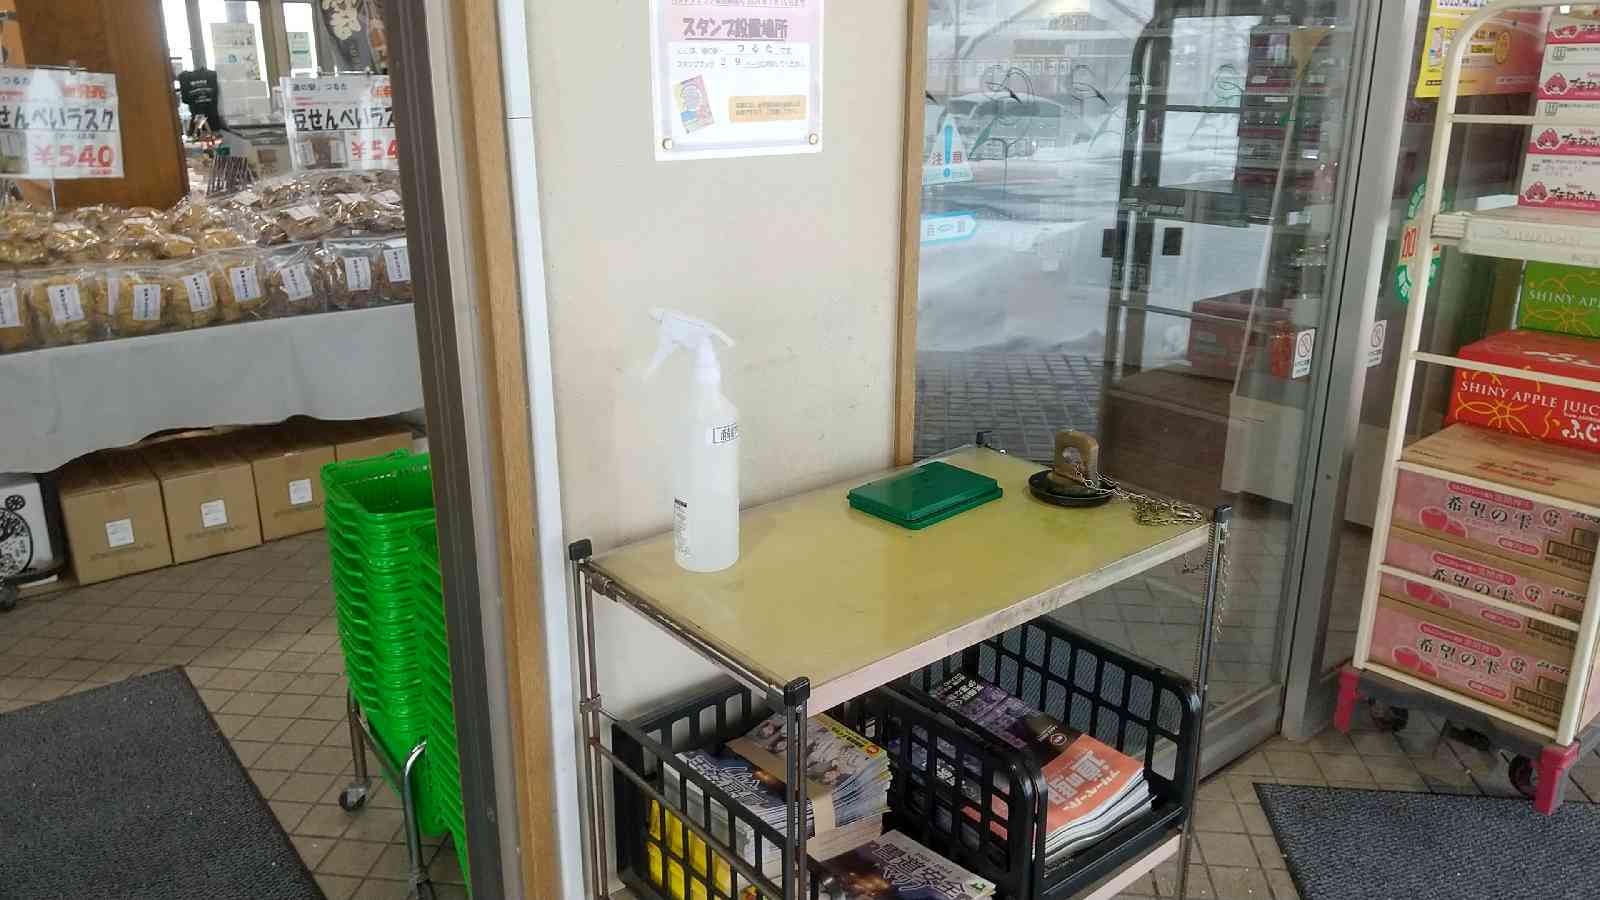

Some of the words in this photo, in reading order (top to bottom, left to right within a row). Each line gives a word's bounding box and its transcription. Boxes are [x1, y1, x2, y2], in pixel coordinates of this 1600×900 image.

[682, 17, 789, 38] スタンプ設置場所
[32, 143, 115, 168] ¥540
[1528, 288, 1575, 306] SHINY
[1460, 380, 1510, 398] SHINY
[1512, 391, 1557, 408] APPLE
[1447, 494, 1533, 531] 希望の雫
[1418, 636, 1501, 676] 希望の雫
